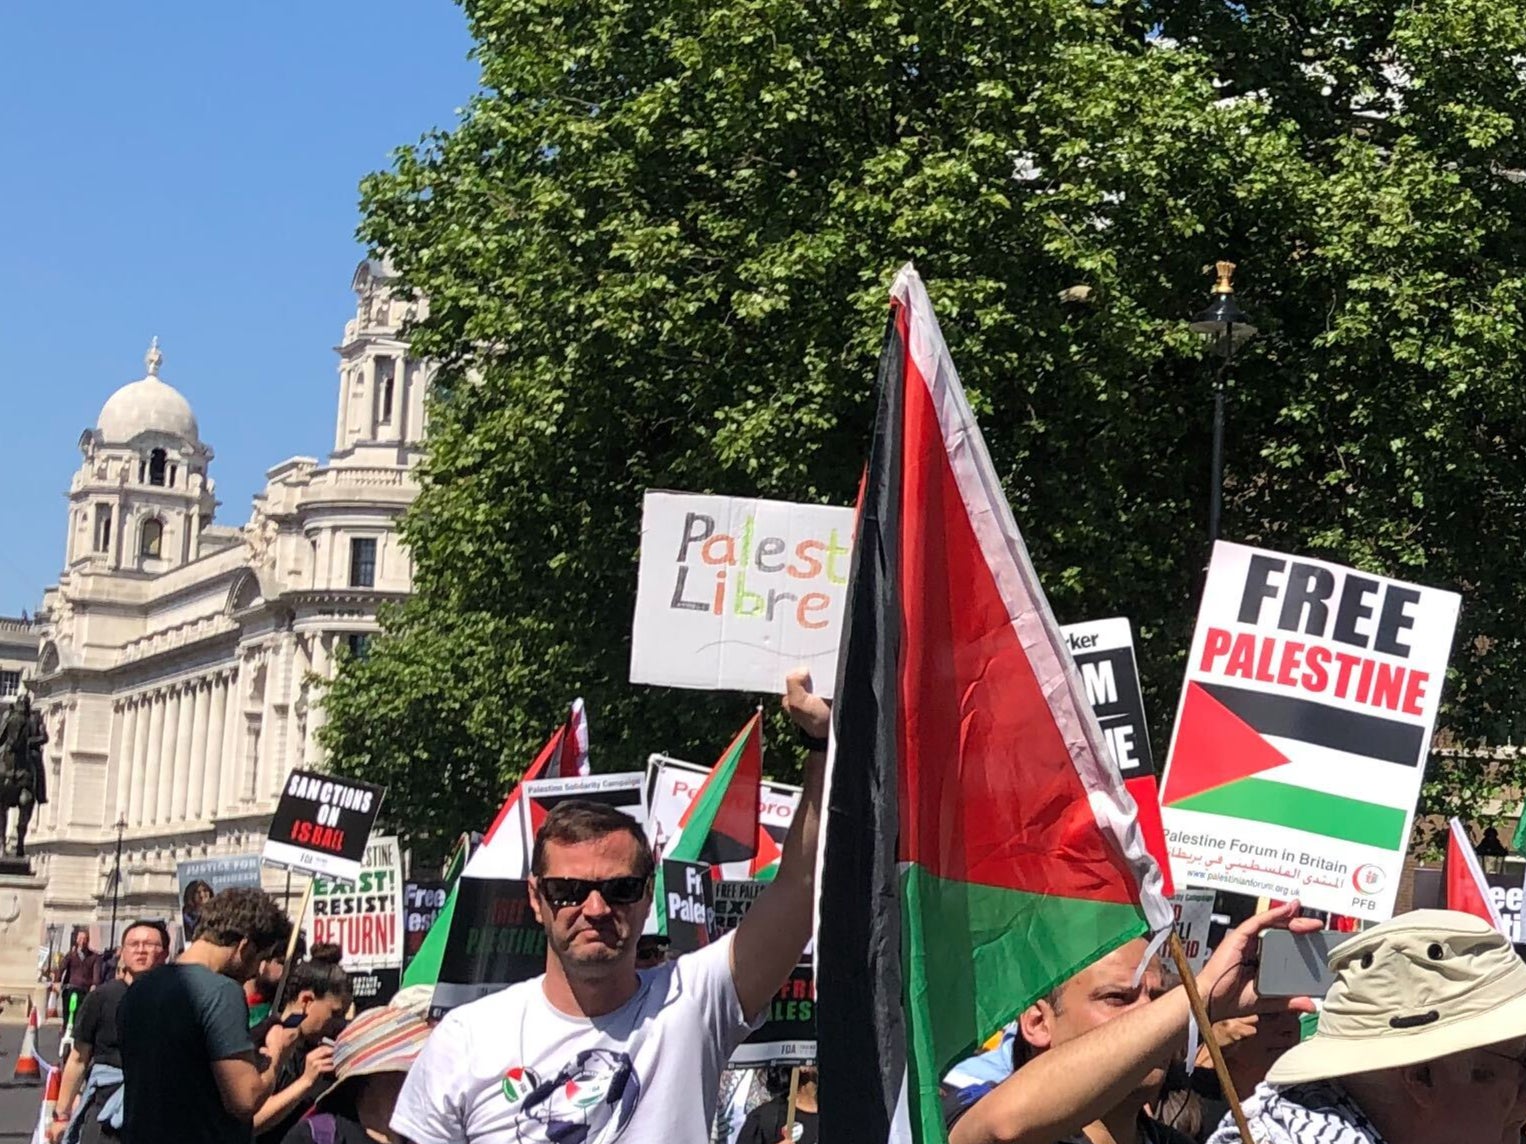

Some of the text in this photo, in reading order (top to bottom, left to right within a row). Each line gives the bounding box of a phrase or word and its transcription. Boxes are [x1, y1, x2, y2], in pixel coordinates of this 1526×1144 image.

[676, 512, 849, 584] Palest
[670, 566, 831, 629] Libre
[1237, 554, 1421, 658] FREE
[1200, 627, 1429, 716] PALESTINE
[288, 775, 373, 813] SANCTIONS
[527, 776, 641, 795] Palestine Solidarity Campaign
[317, 804, 341, 827] ON
[1230, 838, 1278, 858] Forum
[1283, 847, 1295, 862] in
[1300, 852, 1347, 874] Britain
[313, 896, 395, 916] RESIST!
[405, 883, 446, 908] Free
[1351, 897, 1376, 911] PFB
[313, 914, 395, 955] RETURN!
